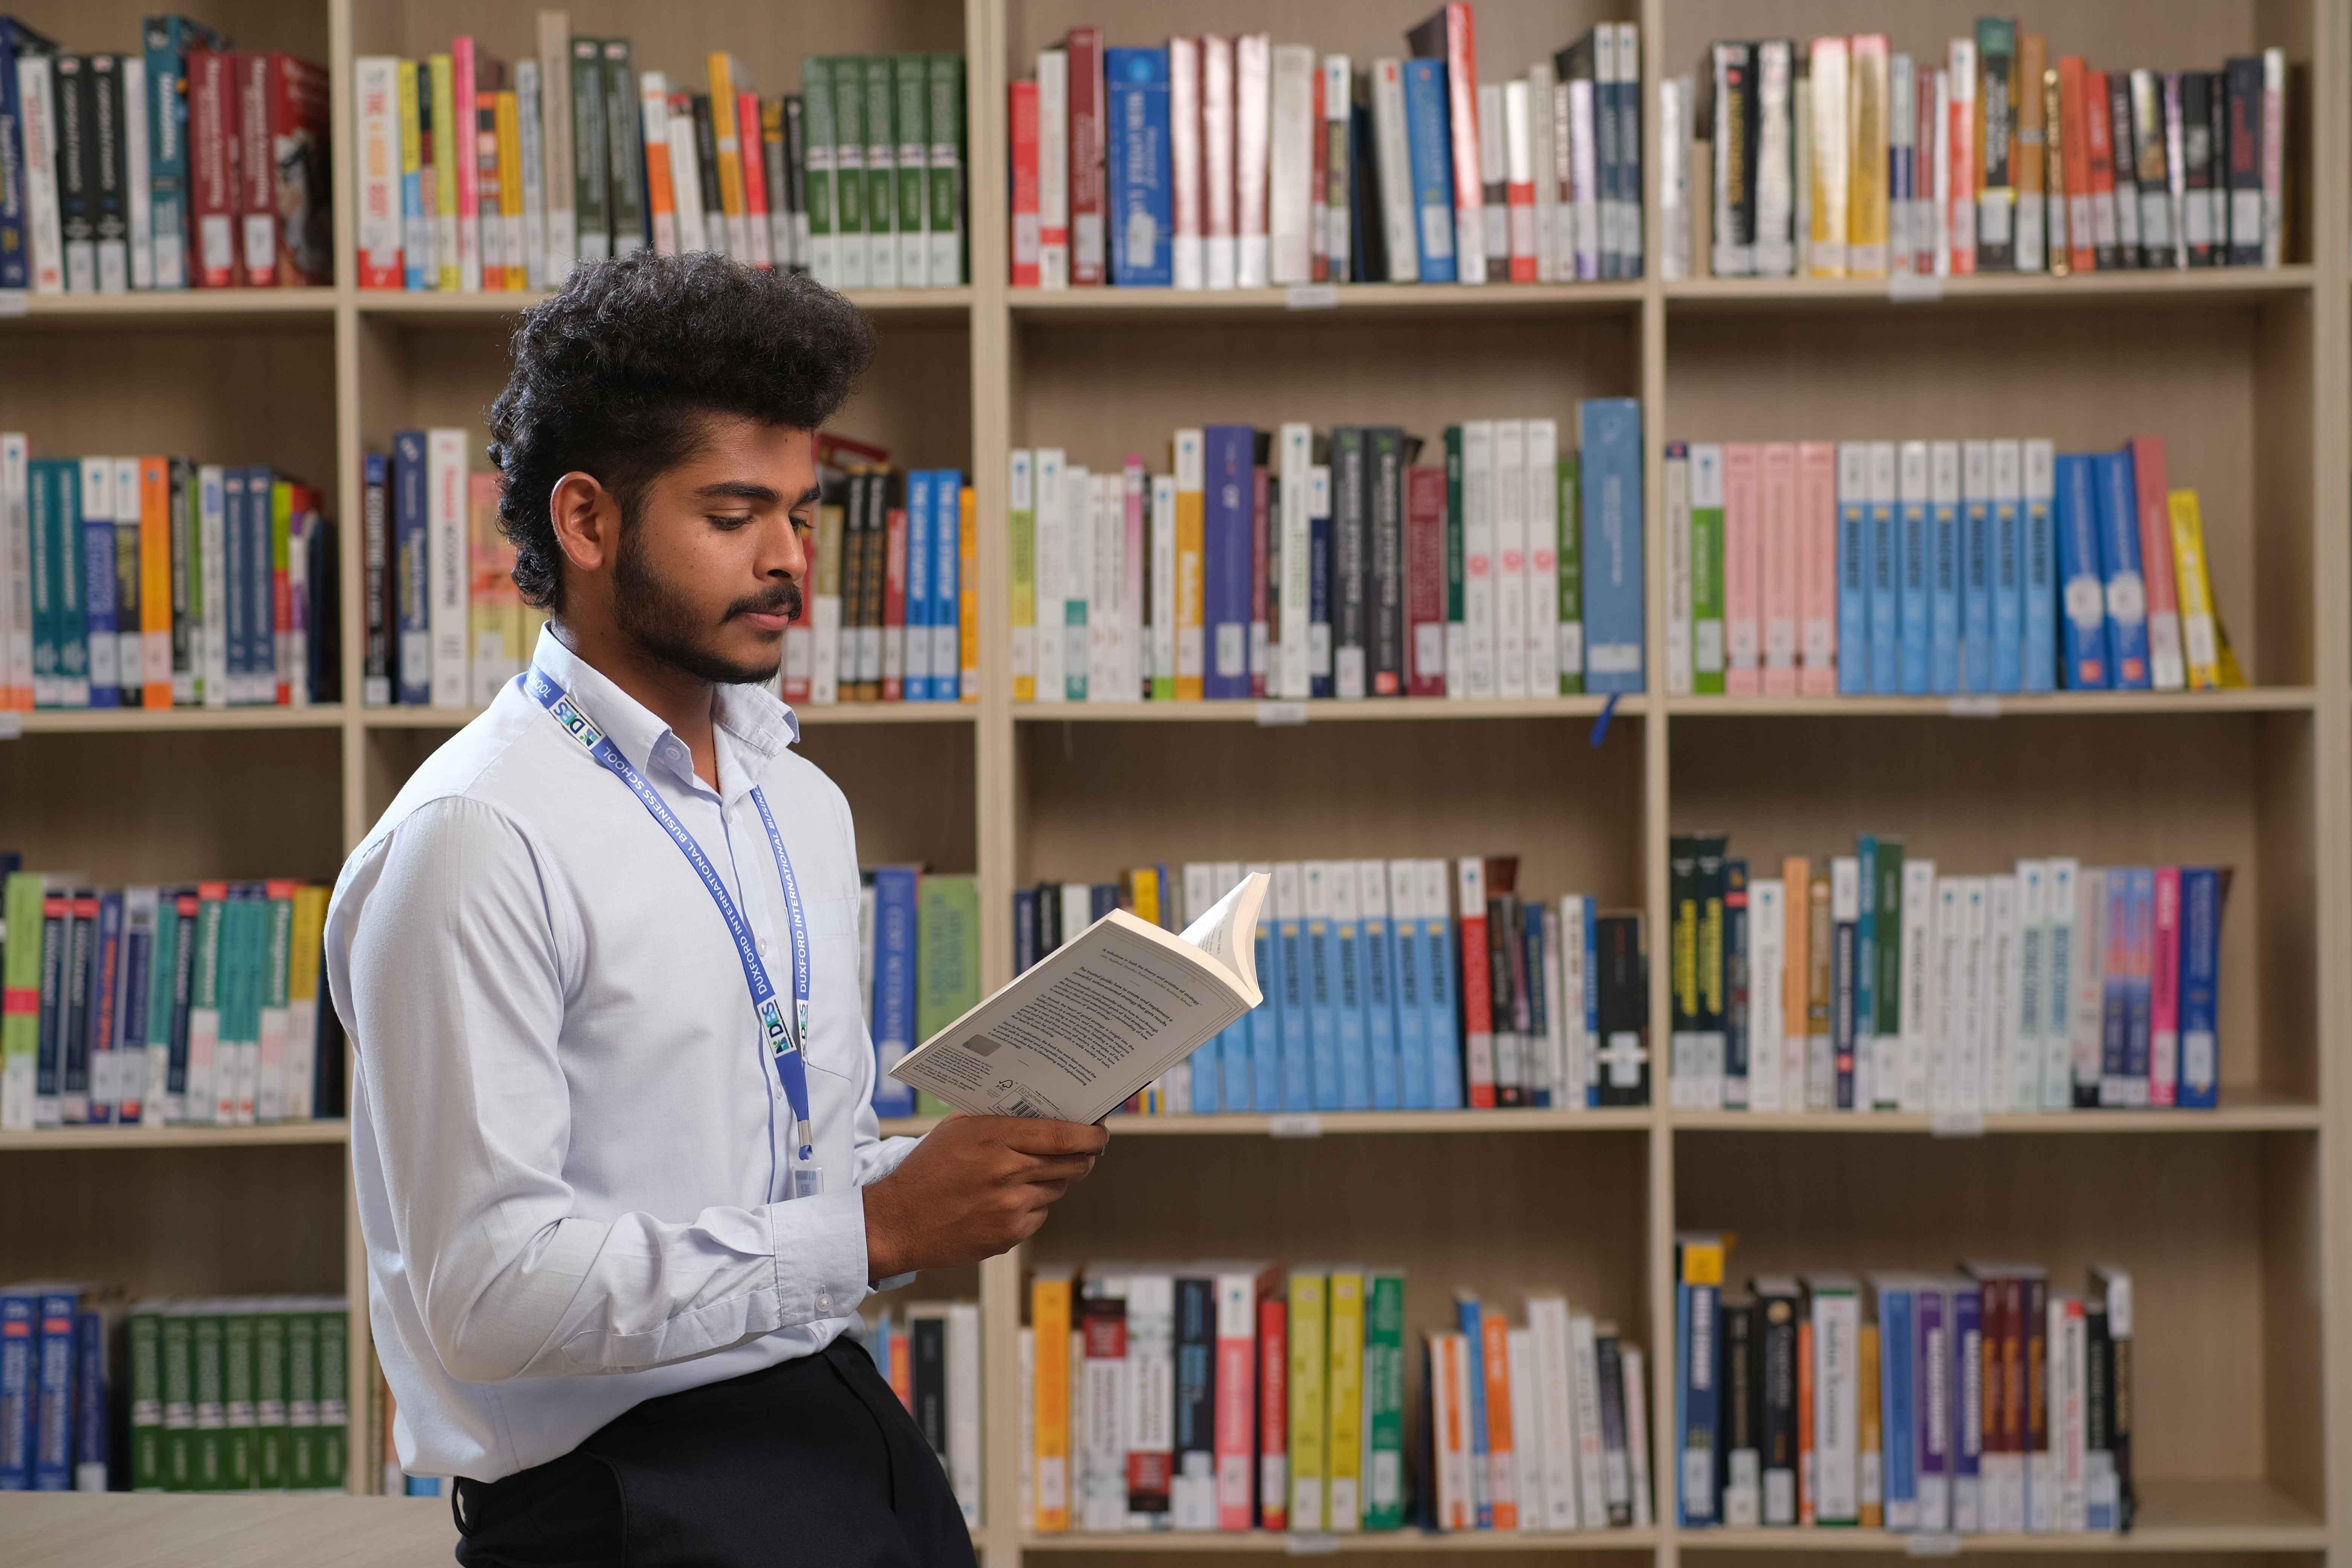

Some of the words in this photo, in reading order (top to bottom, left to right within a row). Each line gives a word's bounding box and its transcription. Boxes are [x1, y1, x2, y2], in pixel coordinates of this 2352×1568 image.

[603, 746, 645, 790] SCHOOL
[643, 789, 688, 843] BUSINESS
[688, 841, 743, 935] INTERNATIONAL
[773, 831, 802, 928] INTERNATIONAL
[740, 936, 767, 995] DUXFORD
[796, 929, 807, 993] DUXFORD
[1143, 968, 1156, 976] theory
[1163, 980, 1179, 990] practice
[1086, 970, 1102, 978] trusted
[1127, 991, 1140, 999] create
[1148, 1003, 1170, 1019] implement
[1120, 994, 1138, 1005] strategy
[1153, 1015, 1167, 1026] results
[1048, 1008, 1065, 1019] launching
[1090, 1032, 1106, 1043] heading
[1108, 1044, 1121, 1054] school
[1090, 1019, 1106, 1029] strategy
[1109, 1030, 1121, 1040] insight
[1101, 994, 1117, 1005] bestseller
[1144, 1021, 1158, 1033] through
[1111, 1014, 1136, 1031] understanding
[1046, 1026, 1065, 1036] cultivated
[1084, 1048, 1097, 1058] variety
[1072, 1027, 1087, 1038] Drawing
[1092, 1040, 1109, 1053] examples
[1093, 1027, 1114, 1042] appropriate
[1113, 1041, 1130, 1054] response
[1095, 1049, 1107, 1058] shows
[1037, 1050, 1057, 1064] developing
[1063, 1067, 1087, 1086] implementing
[1039, 1046, 1058, 1057] pragmatic
[1075, 1069, 1092, 1082] continues
[1078, 1063, 1092, 1074] around
[1024, 1091, 1043, 1106] hachette
